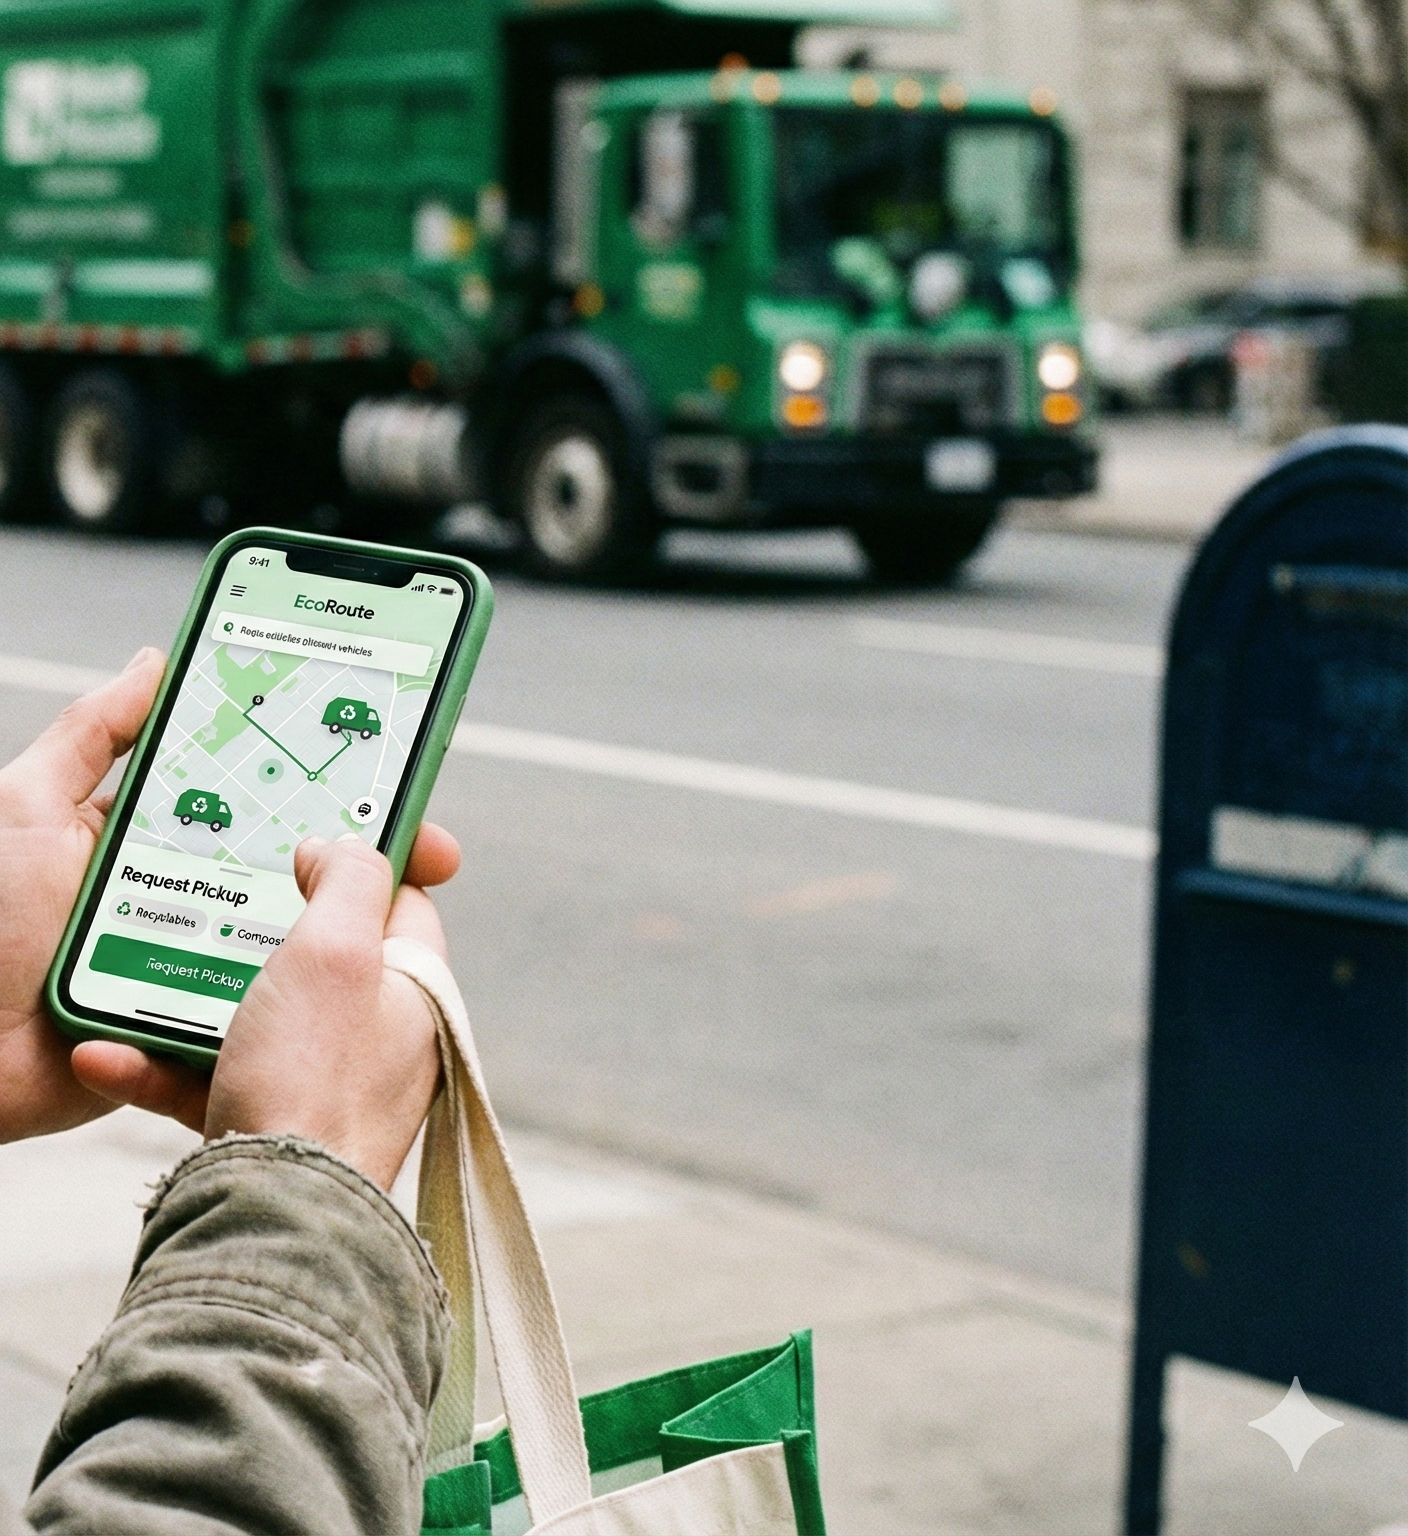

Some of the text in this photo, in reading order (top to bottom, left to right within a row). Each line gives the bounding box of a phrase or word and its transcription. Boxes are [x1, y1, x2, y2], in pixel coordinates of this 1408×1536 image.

[248, 556, 270, 568] 9:41
[294, 594, 375, 619] EcoRoute
[121, 865, 249, 907] Request Pickup
[146, 957, 245, 991] Request Pickup
